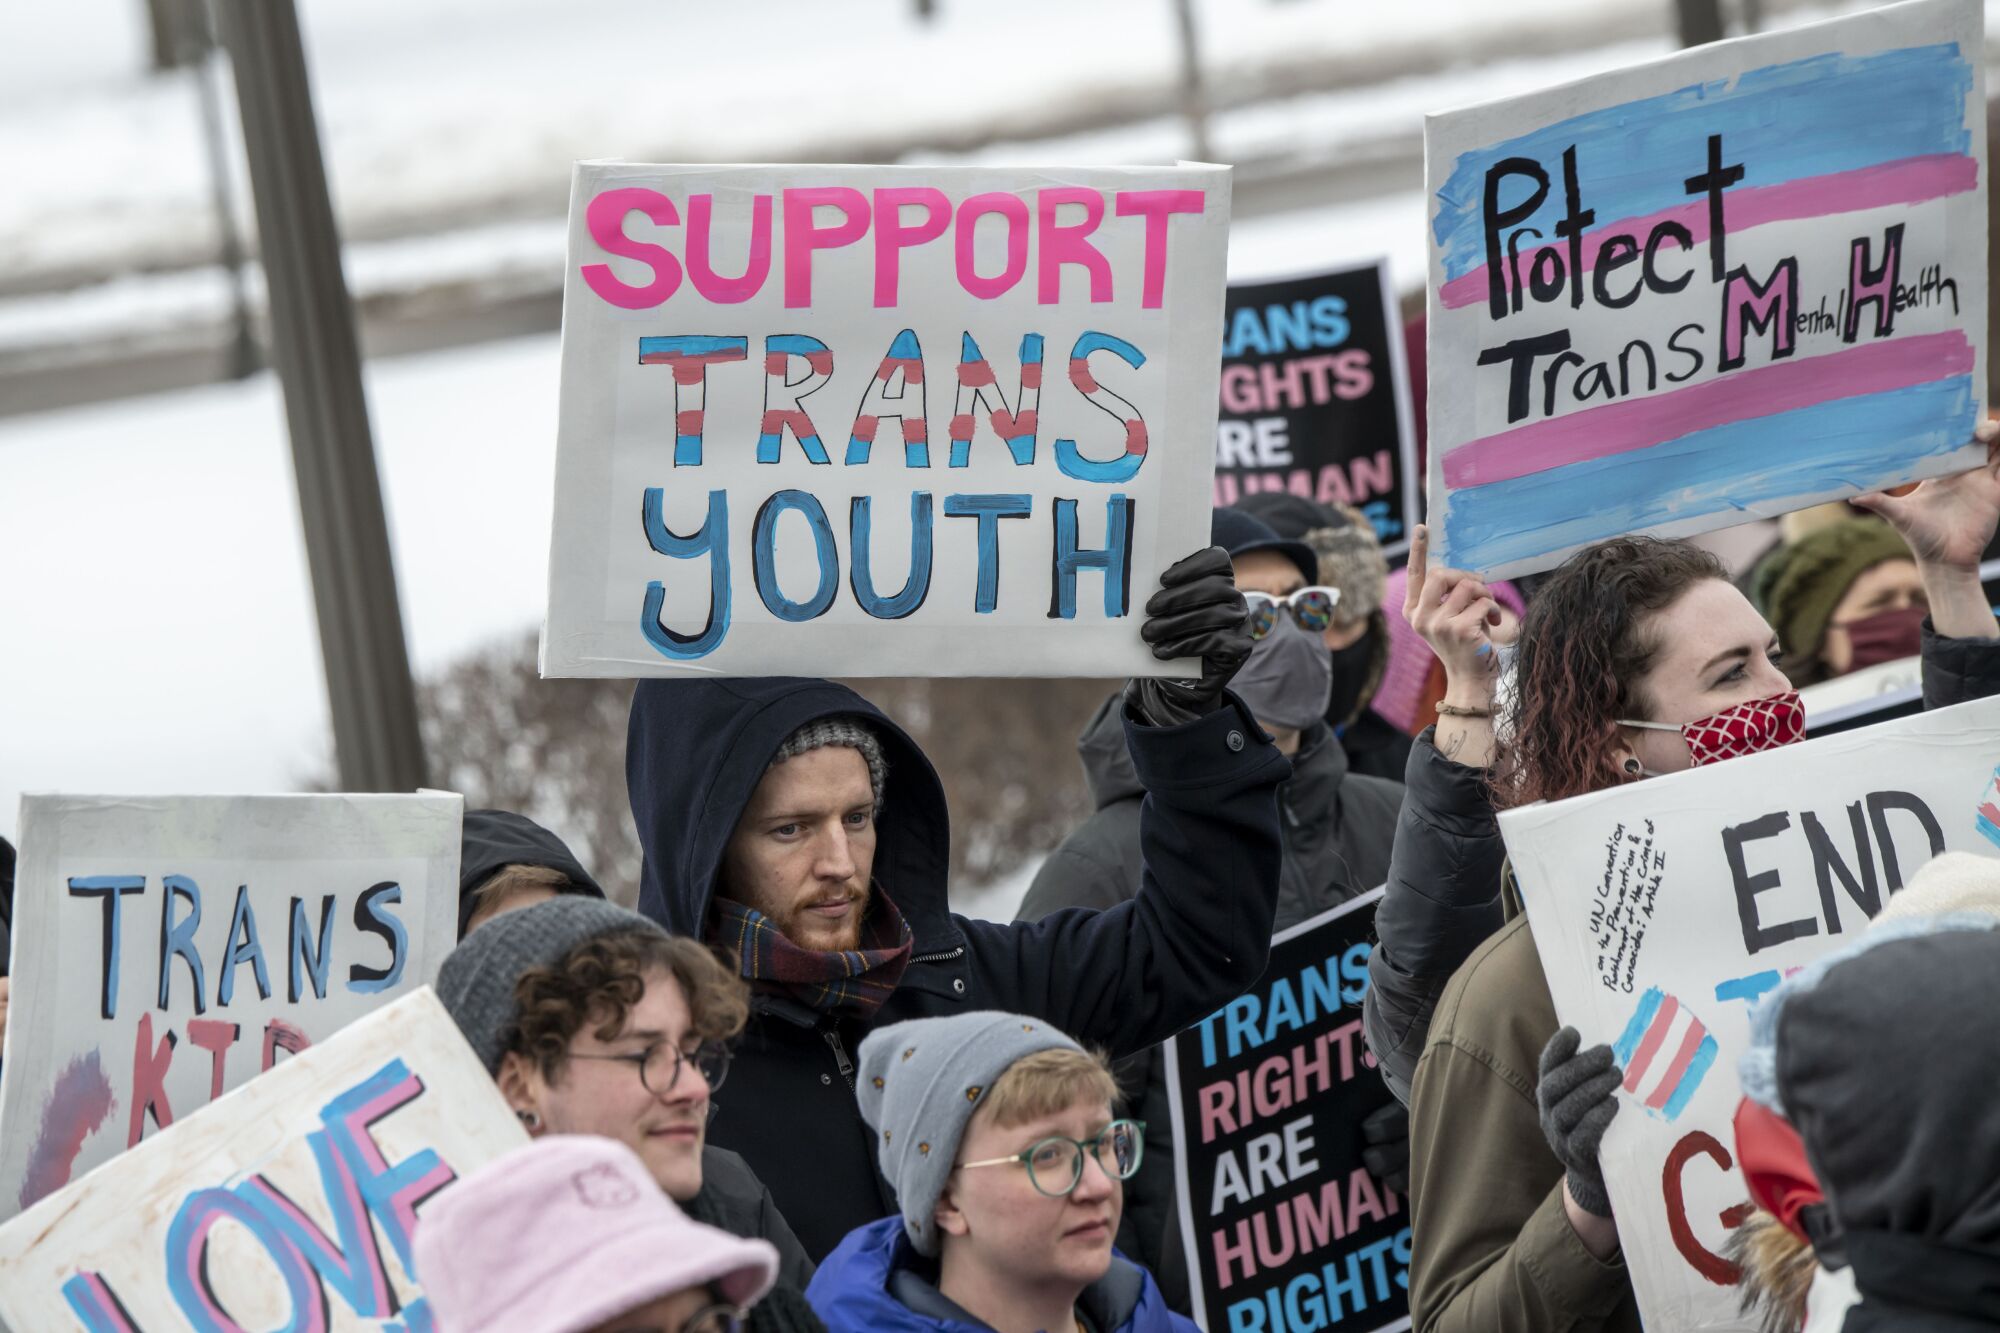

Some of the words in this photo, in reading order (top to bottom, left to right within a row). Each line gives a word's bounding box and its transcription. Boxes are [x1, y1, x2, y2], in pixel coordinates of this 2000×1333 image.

[581, 186, 1205, 310] SUPPORT
[1484, 134, 1745, 321] Protect
[1222, 295, 1351, 357] ANS
[1477, 323, 1705, 424] Trans
[1718, 256, 1845, 373] Mental
[1843, 222, 1959, 343] Health
[638, 328, 1149, 484] TRANS
[1216, 417, 1293, 469] RE
[640, 487, 1136, 660] YOUTH
[1589, 899, 1605, 933] UN
[1597, 822, 1625, 898] Convention
[1637, 838, 1652, 879] Crime
[1645, 818, 1655, 835] of
[1722, 791, 1945, 955] END
[1597, 955, 1605, 971] on
[1601, 933, 1611, 949] the
[1606, 849, 1636, 932] Prevention
[1626, 906, 1635, 925] of
[1629, 884, 1644, 904] the
[1641, 876, 1662, 919] Article
[1653, 851, 1665, 871] II
[68, 874, 408, 1020] TRANS
[1193, 942, 1373, 1067] TRANS
[1602, 925, 1629, 992] Punishment
[1199, 1019, 1377, 1144] RIGHT
[1210, 1115, 1320, 1216] ARE
